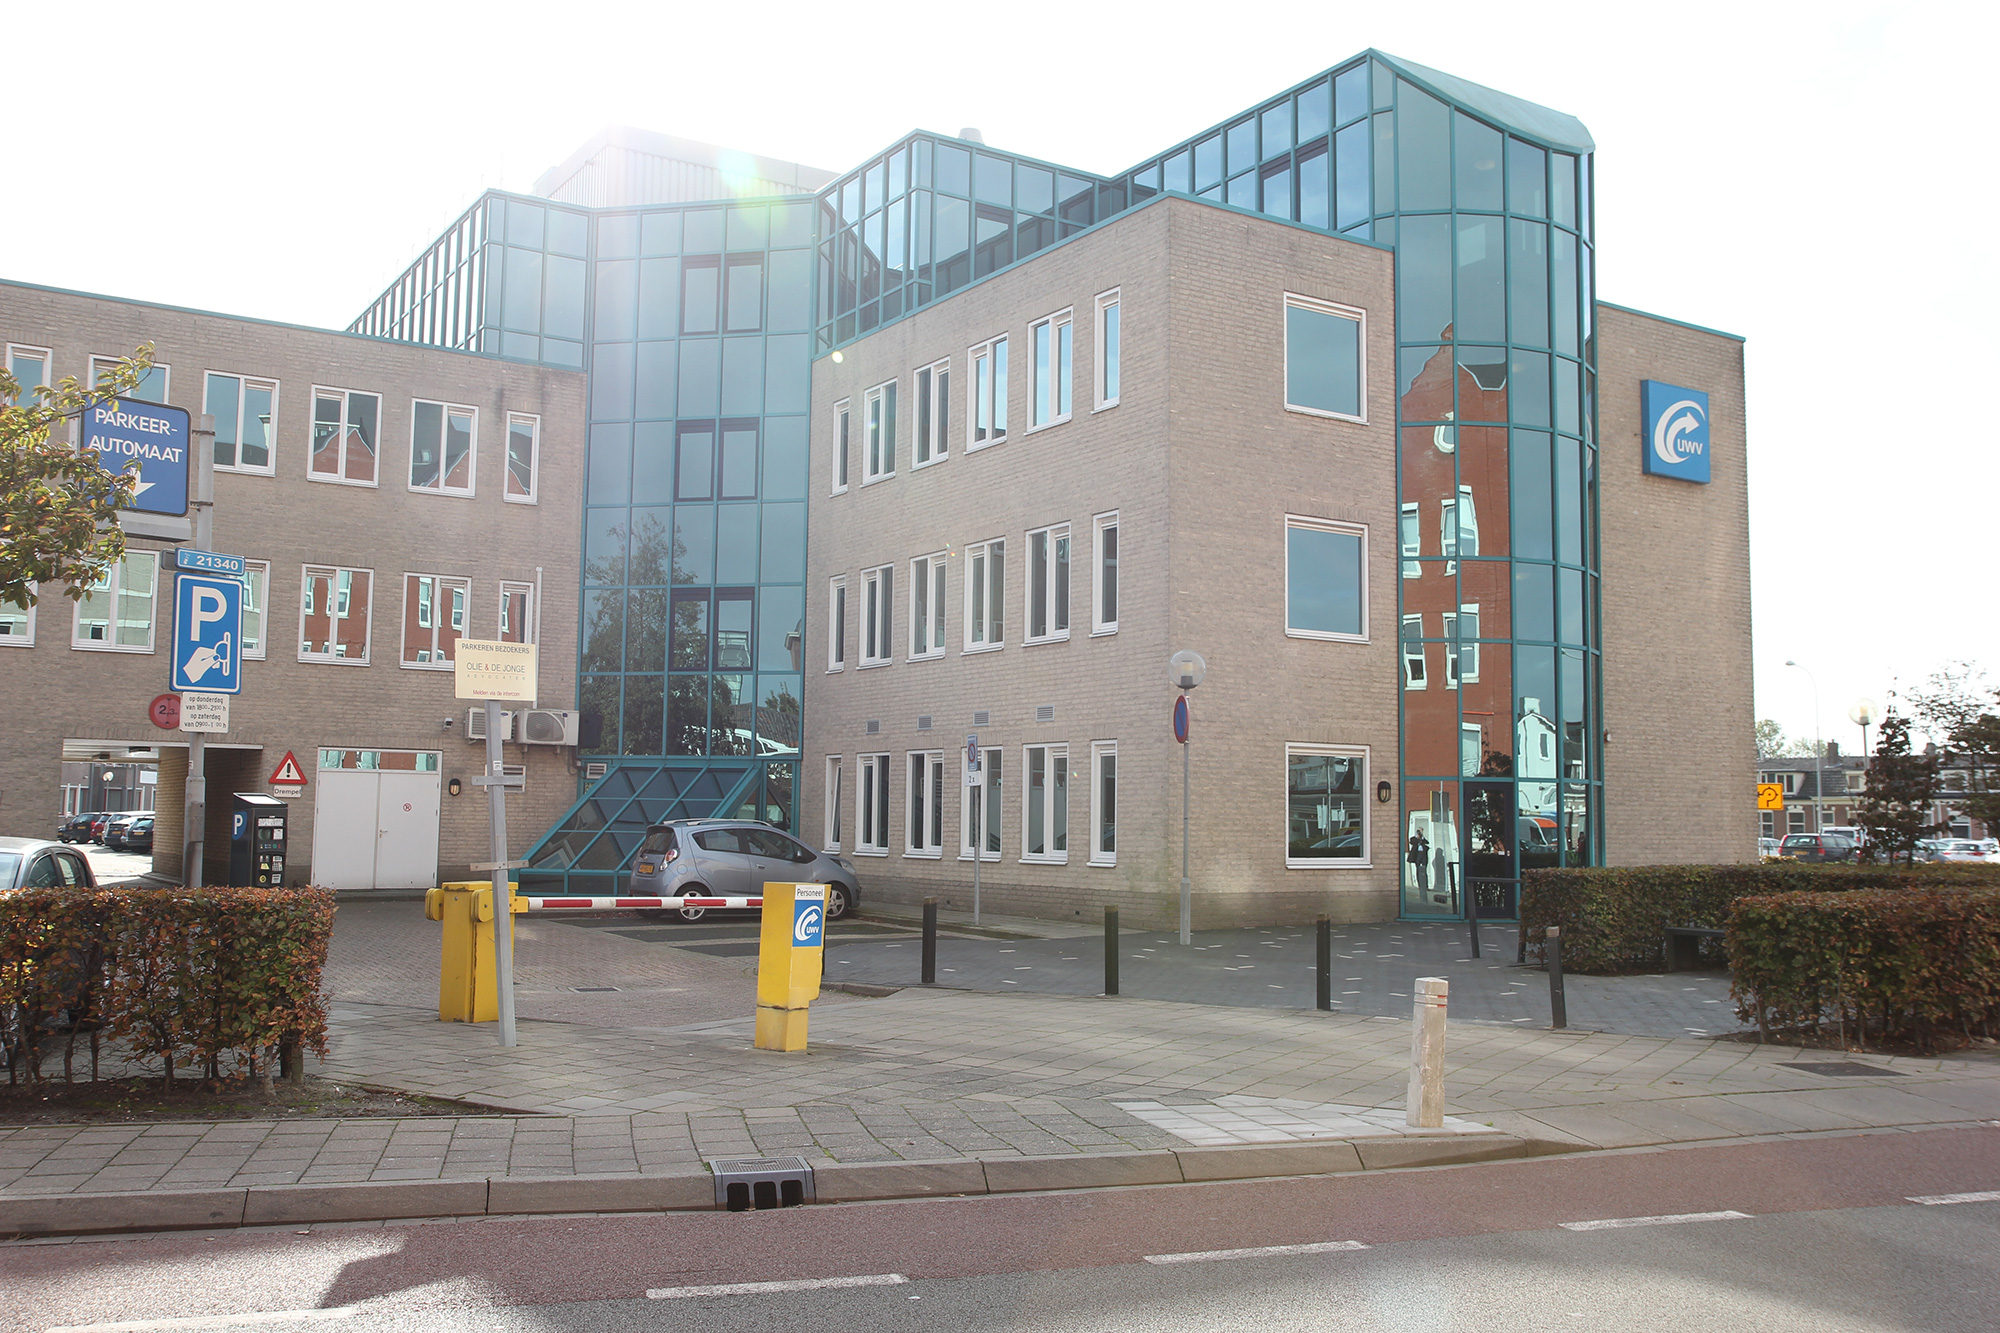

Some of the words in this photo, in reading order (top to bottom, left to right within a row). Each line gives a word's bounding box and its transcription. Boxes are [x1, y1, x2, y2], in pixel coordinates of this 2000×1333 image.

[96, 408, 178, 435] PARKEER-
[88, 435, 182, 462] AUTOMAAT
[196, 556, 238, 570] 21340
[190, 586, 228, 642] P
[462, 643, 494, 651] PARKEREN
[495, 645, 530, 654] BEZOEKERS
[491, 664, 501, 672] DE
[502, 664, 526, 673] JONGE
[968, 775, 972, 783] 2
[234, 814, 243, 835] P
[797, 888, 823, 896] Personeel
